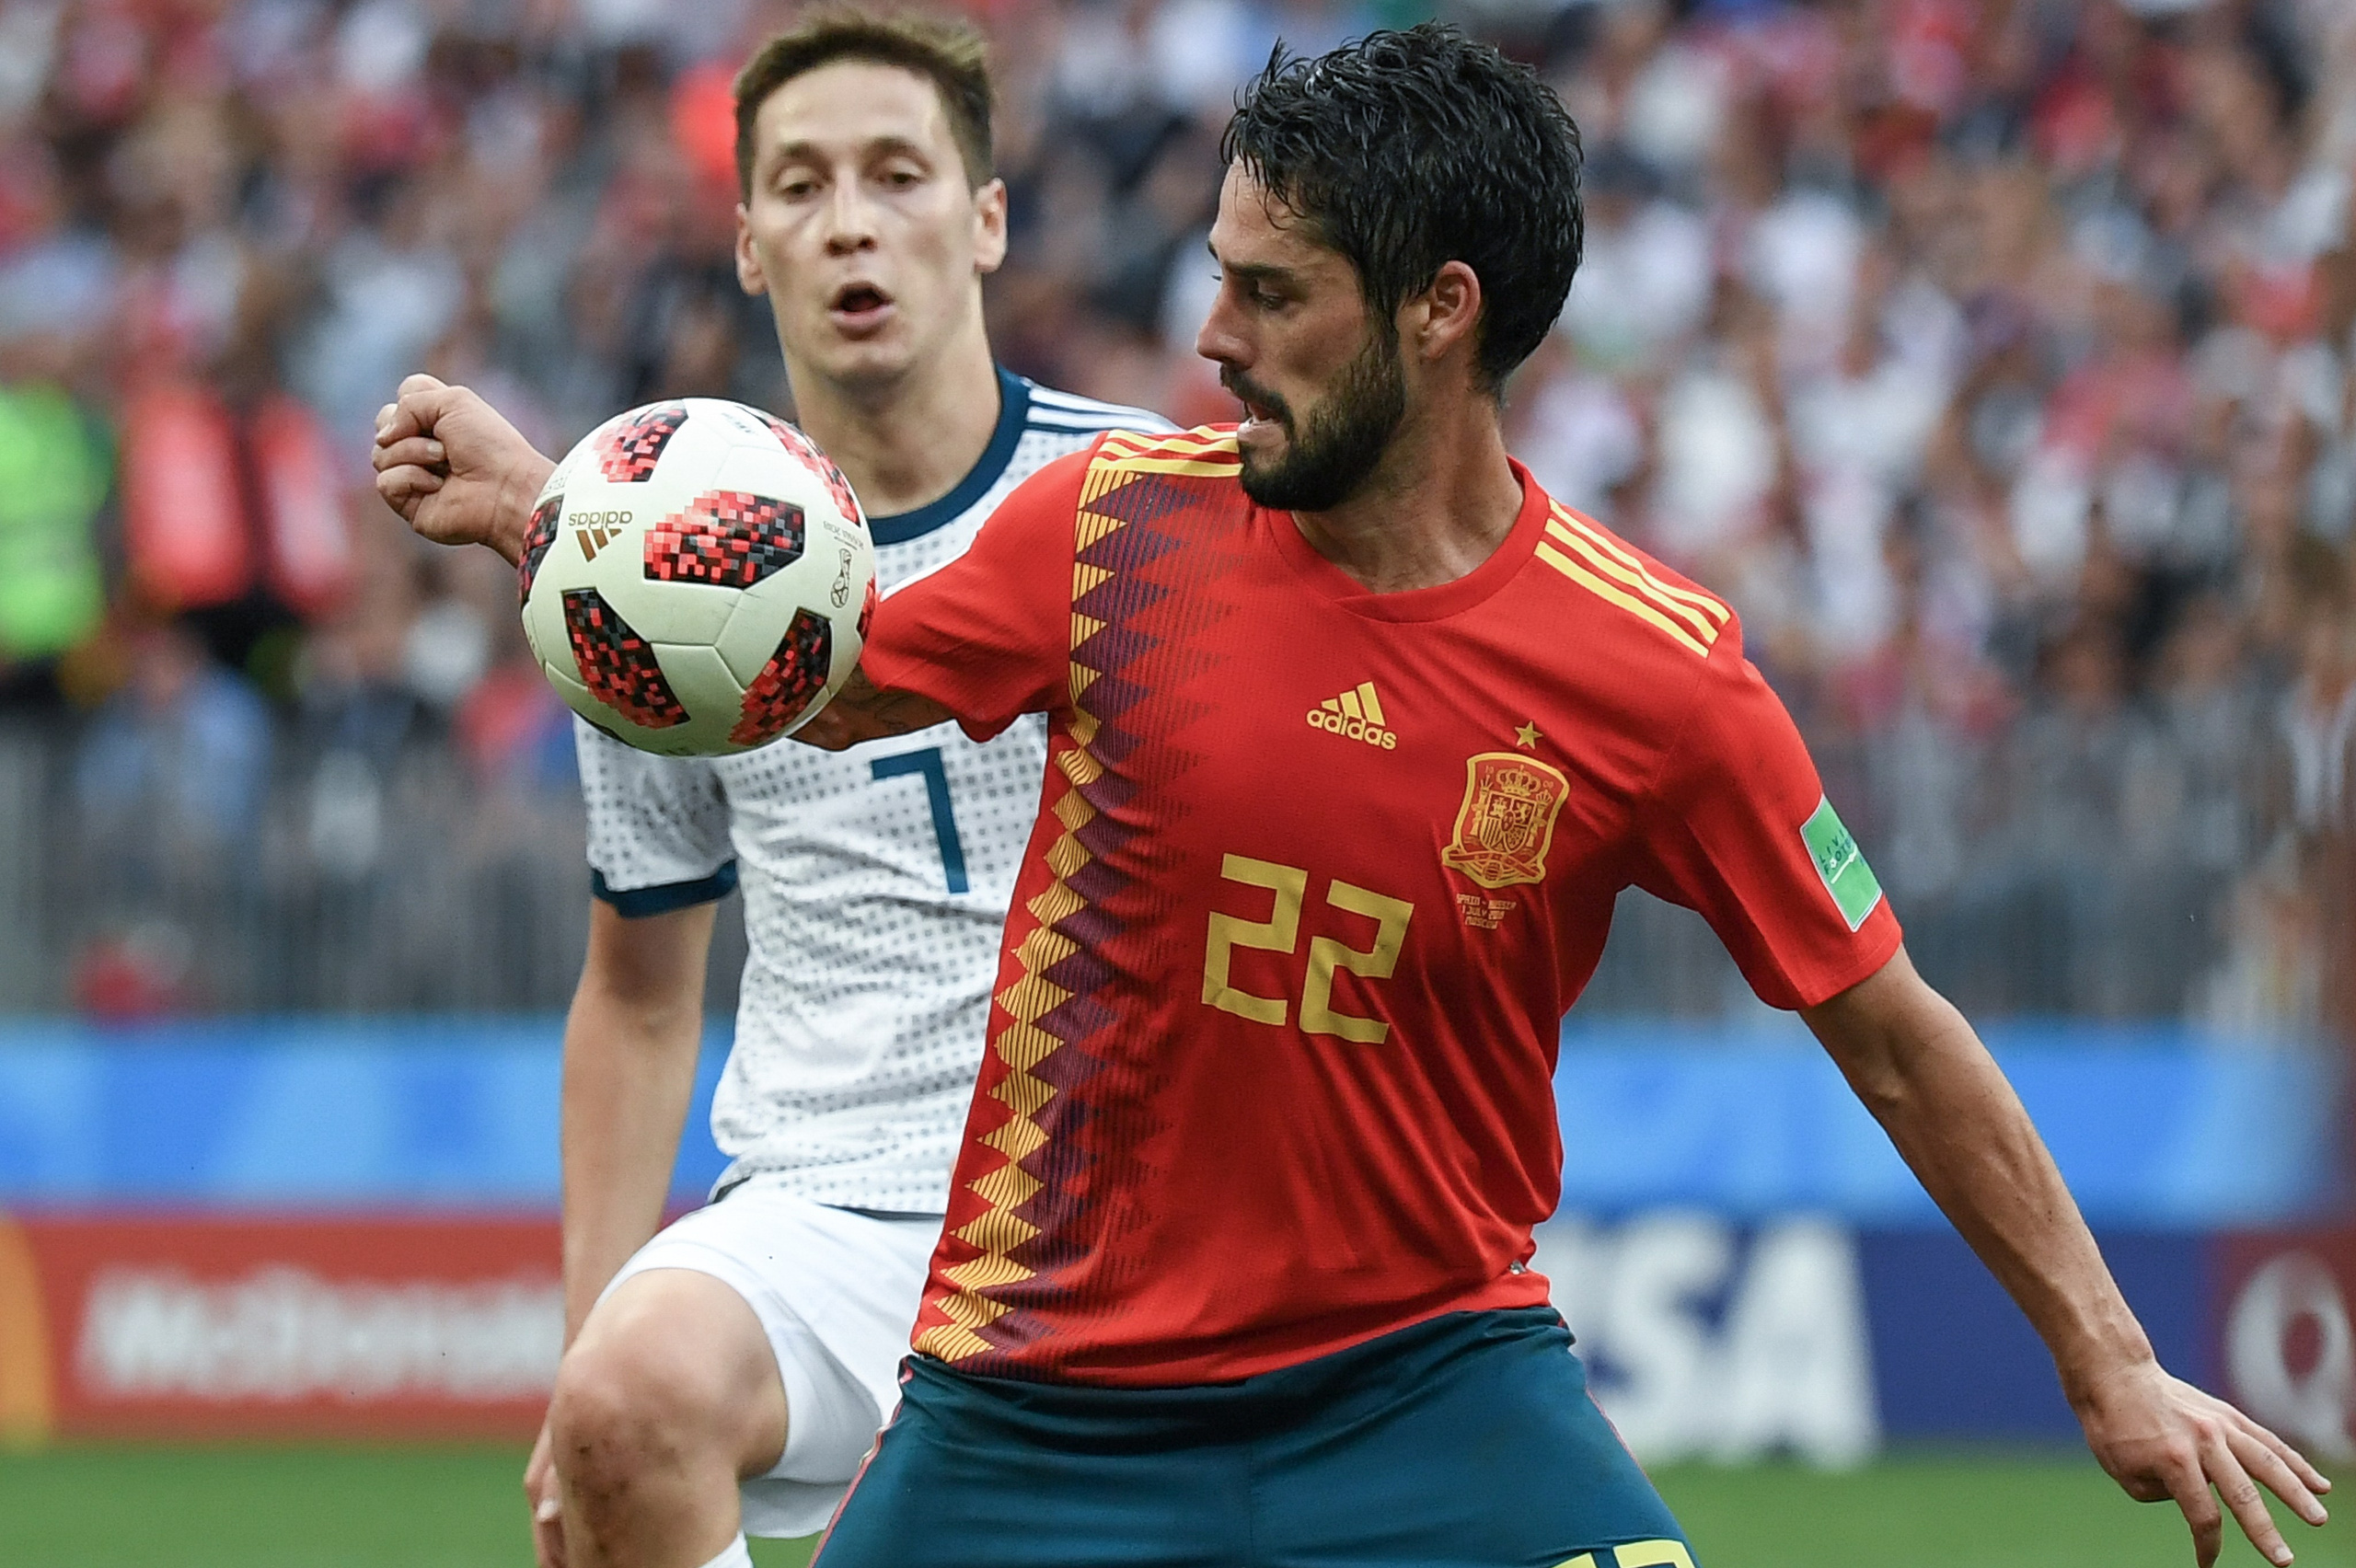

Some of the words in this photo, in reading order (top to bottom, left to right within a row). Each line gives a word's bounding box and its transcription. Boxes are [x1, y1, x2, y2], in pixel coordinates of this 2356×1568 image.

[568, 511, 632, 530] adidas
[1306, 709, 1397, 750] adidas
[870, 746, 970, 894] 7
[1201, 852, 1415, 1043] 22
